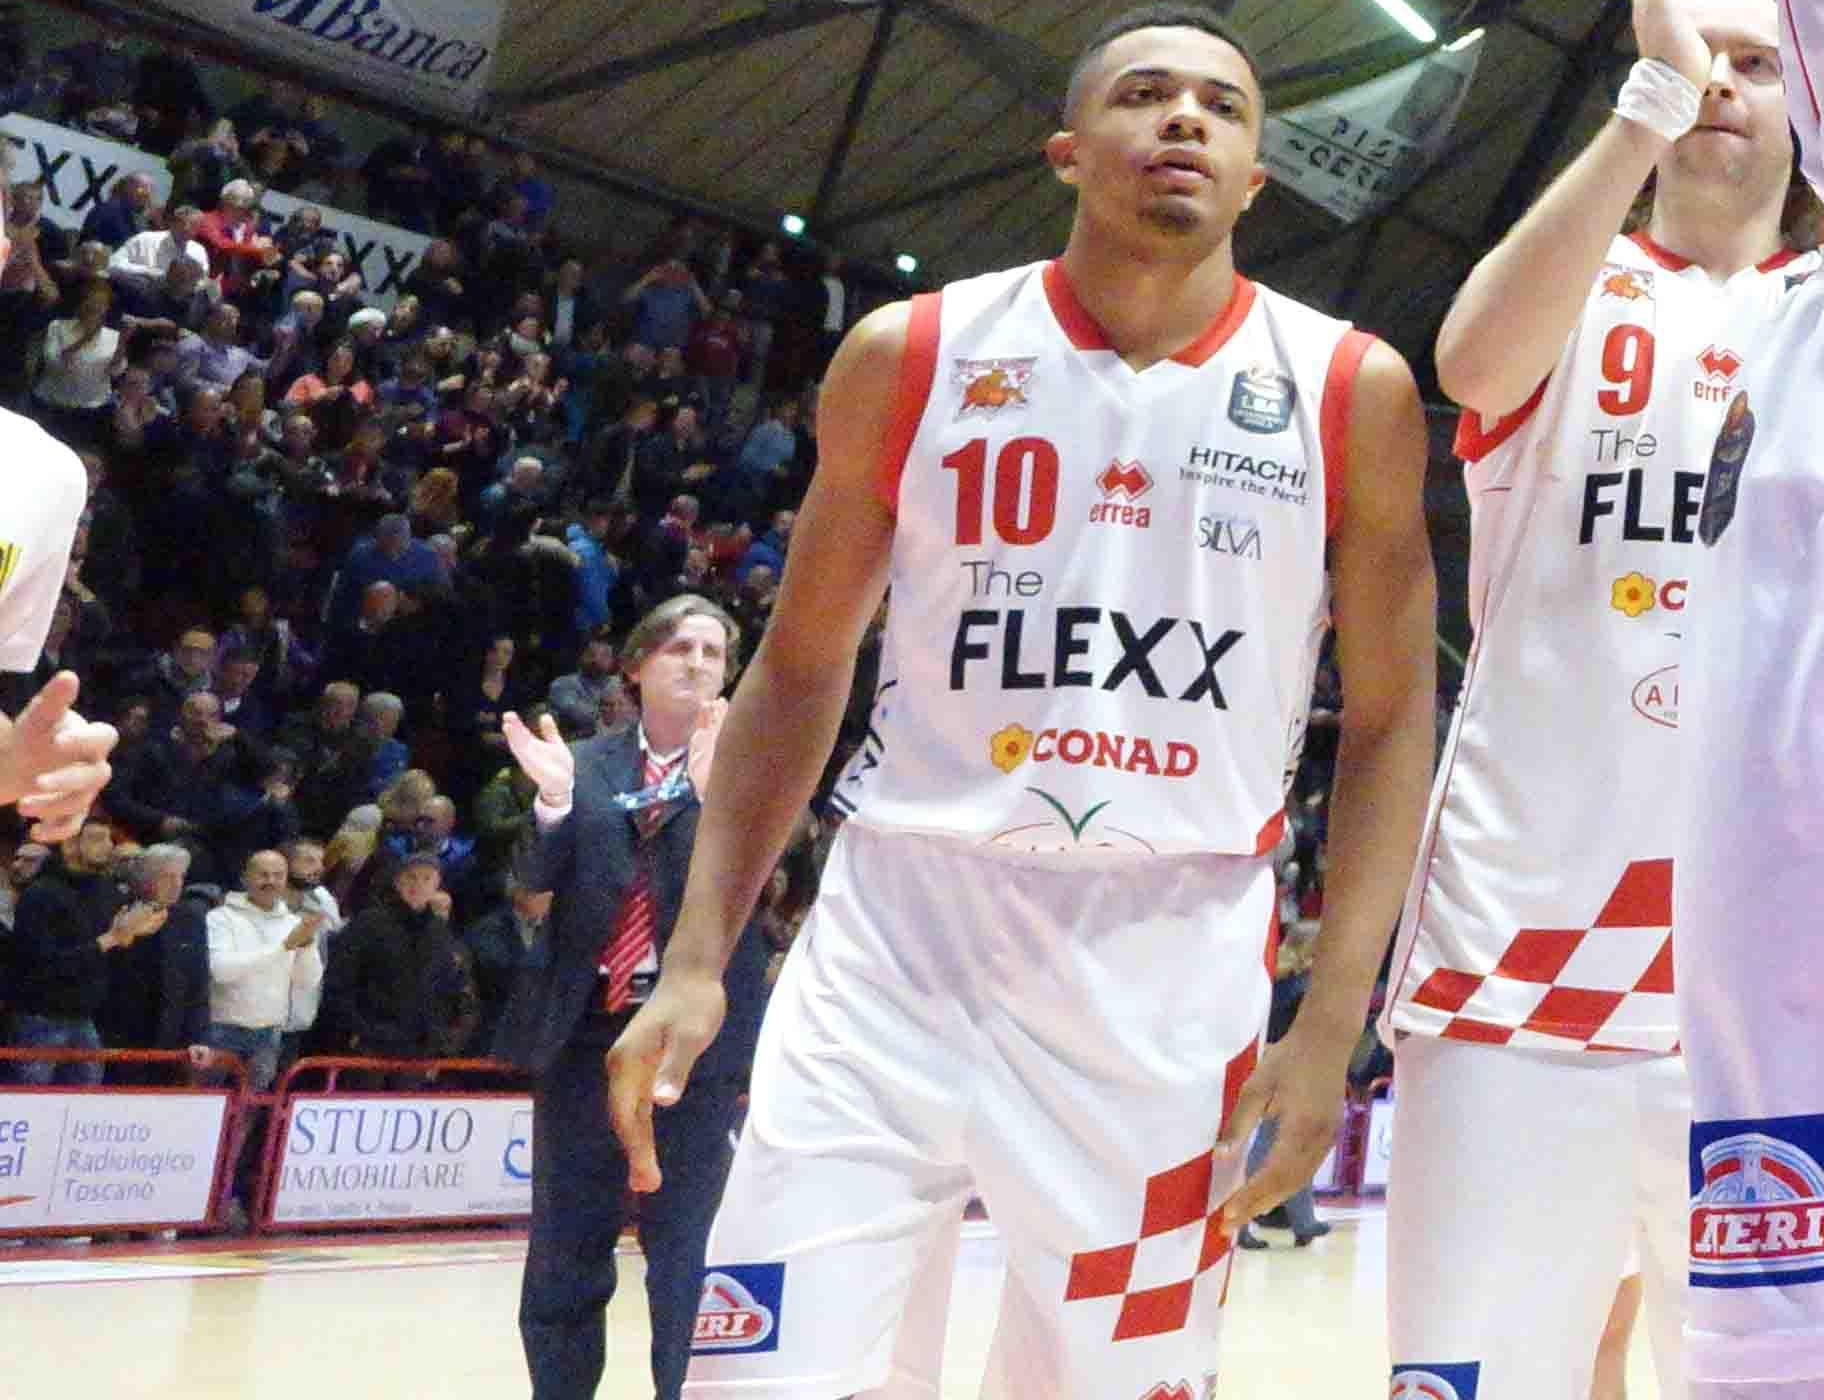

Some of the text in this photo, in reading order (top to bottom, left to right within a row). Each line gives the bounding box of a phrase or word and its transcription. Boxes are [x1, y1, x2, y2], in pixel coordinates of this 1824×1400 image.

[1597, 324, 1655, 416] 9
[1592, 429, 1657, 464] The
[1189, 446, 1306, 491] HITACHI
[1240, 477, 1266, 497] the
[942, 436, 1059, 546] 10
[1579, 469, 1704, 545] FLE
[1089, 502, 1150, 529] errea
[1199, 519, 1262, 560] SILVA
[961, 561, 1042, 598] The
[949, 608, 1244, 711] FLEXX
[1032, 728, 1199, 778] CONAD
[71, 1120, 152, 1144] Istituto
[289, 1107, 474, 1155] STUDIO
[65, 1149, 195, 1174] Radiologico
[279, 1162, 466, 1193] IMMOBILIARE
[62, 1179, 155, 1202] Toscano
